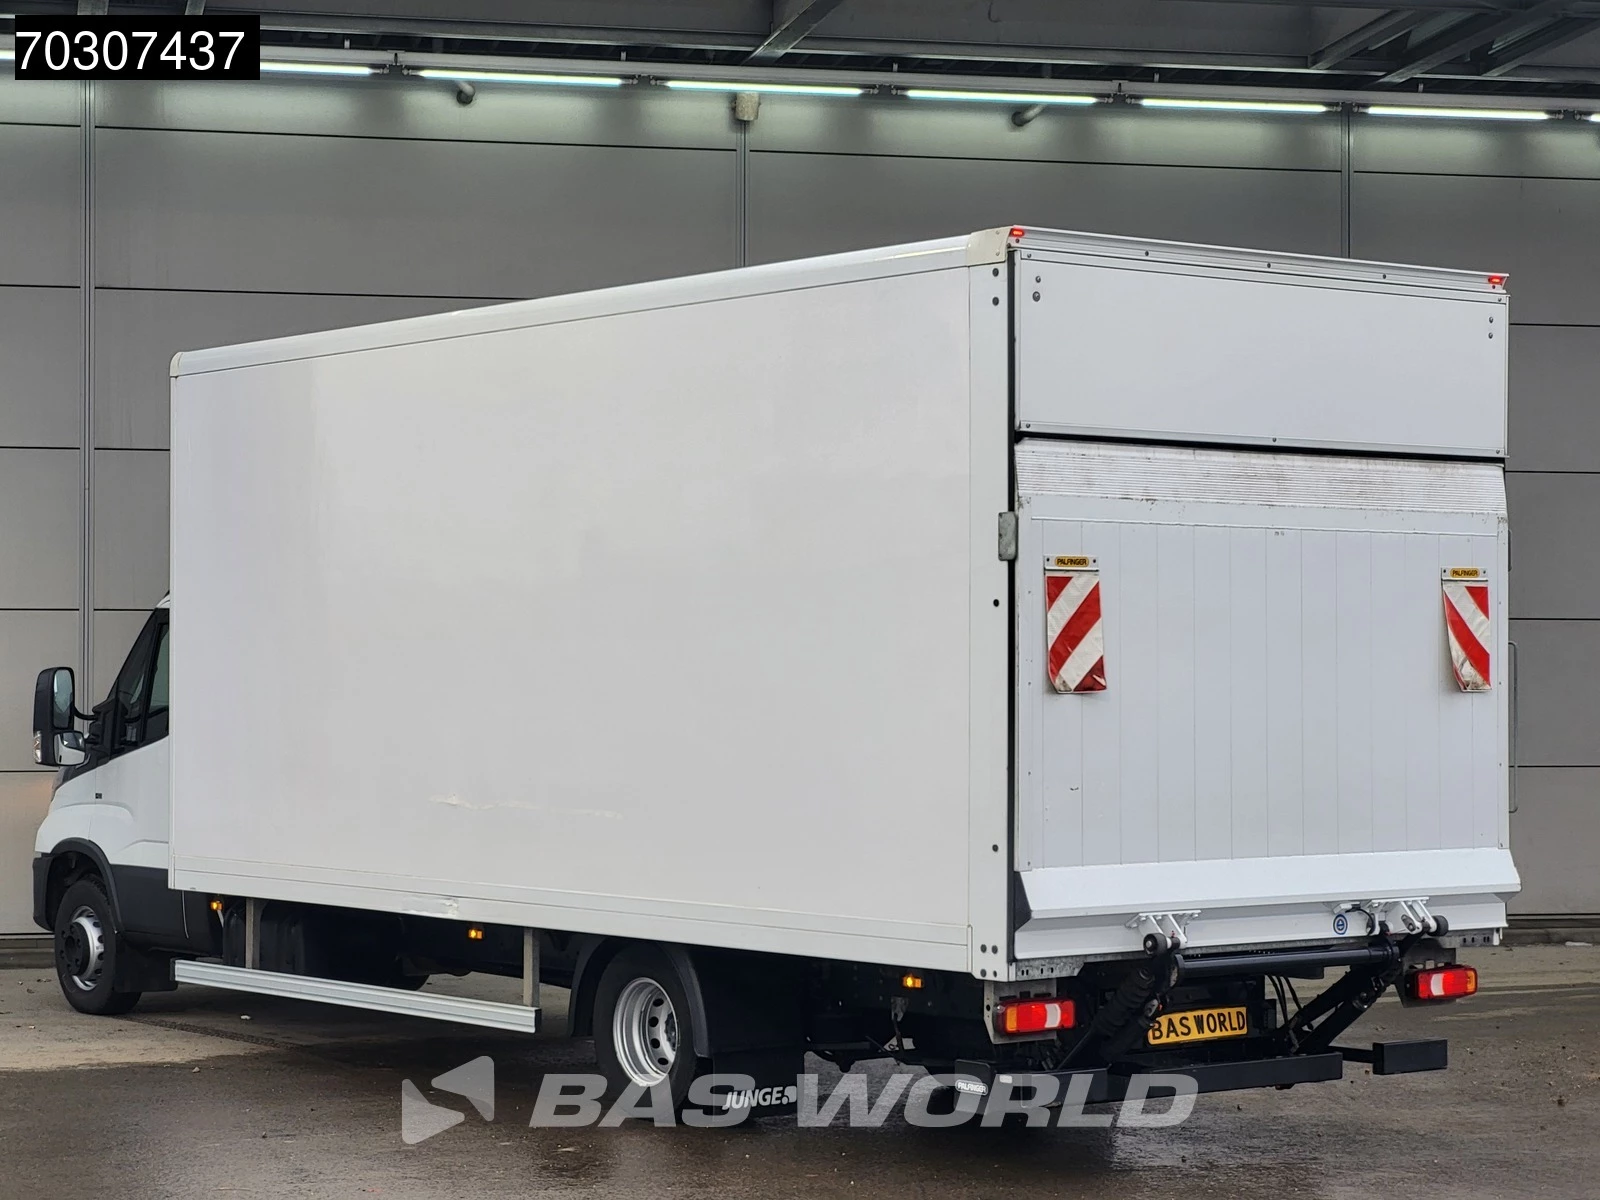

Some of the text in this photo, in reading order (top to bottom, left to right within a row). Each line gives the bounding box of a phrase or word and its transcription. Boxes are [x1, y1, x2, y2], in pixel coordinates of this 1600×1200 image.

[1056, 558, 1087, 566] PALFINGER
[1452, 569, 1479, 577] PALFINGER
[1151, 1011, 1246, 1040] BAS WORLD
[957, 1082, 987, 1094] PALFINGER
